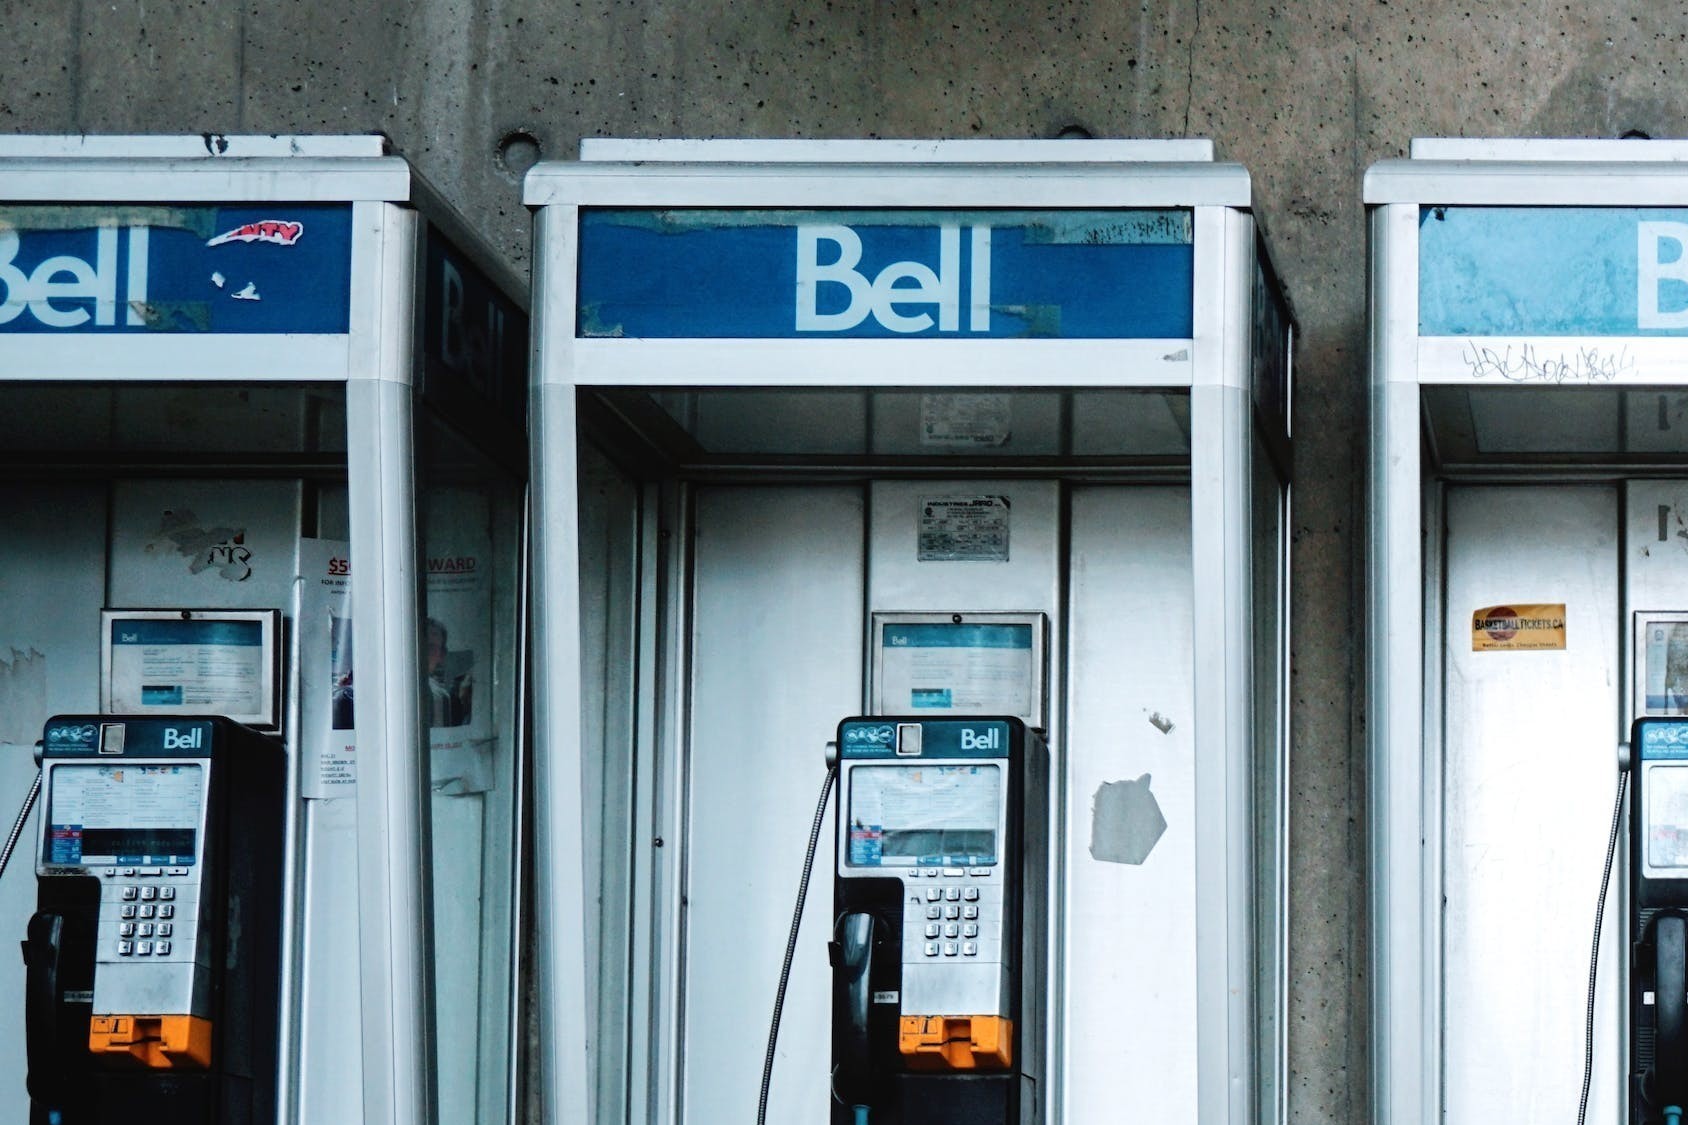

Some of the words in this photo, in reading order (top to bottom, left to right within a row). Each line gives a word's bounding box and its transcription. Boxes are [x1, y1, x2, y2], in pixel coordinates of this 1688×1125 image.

[795, 223, 991, 333] Bell
[328, 556, 351, 572] $5
[121, 632, 137, 642] Bell
[891, 636, 907, 645] Bell
[163, 727, 202, 749] Bell
[961, 728, 999, 750] Bell
